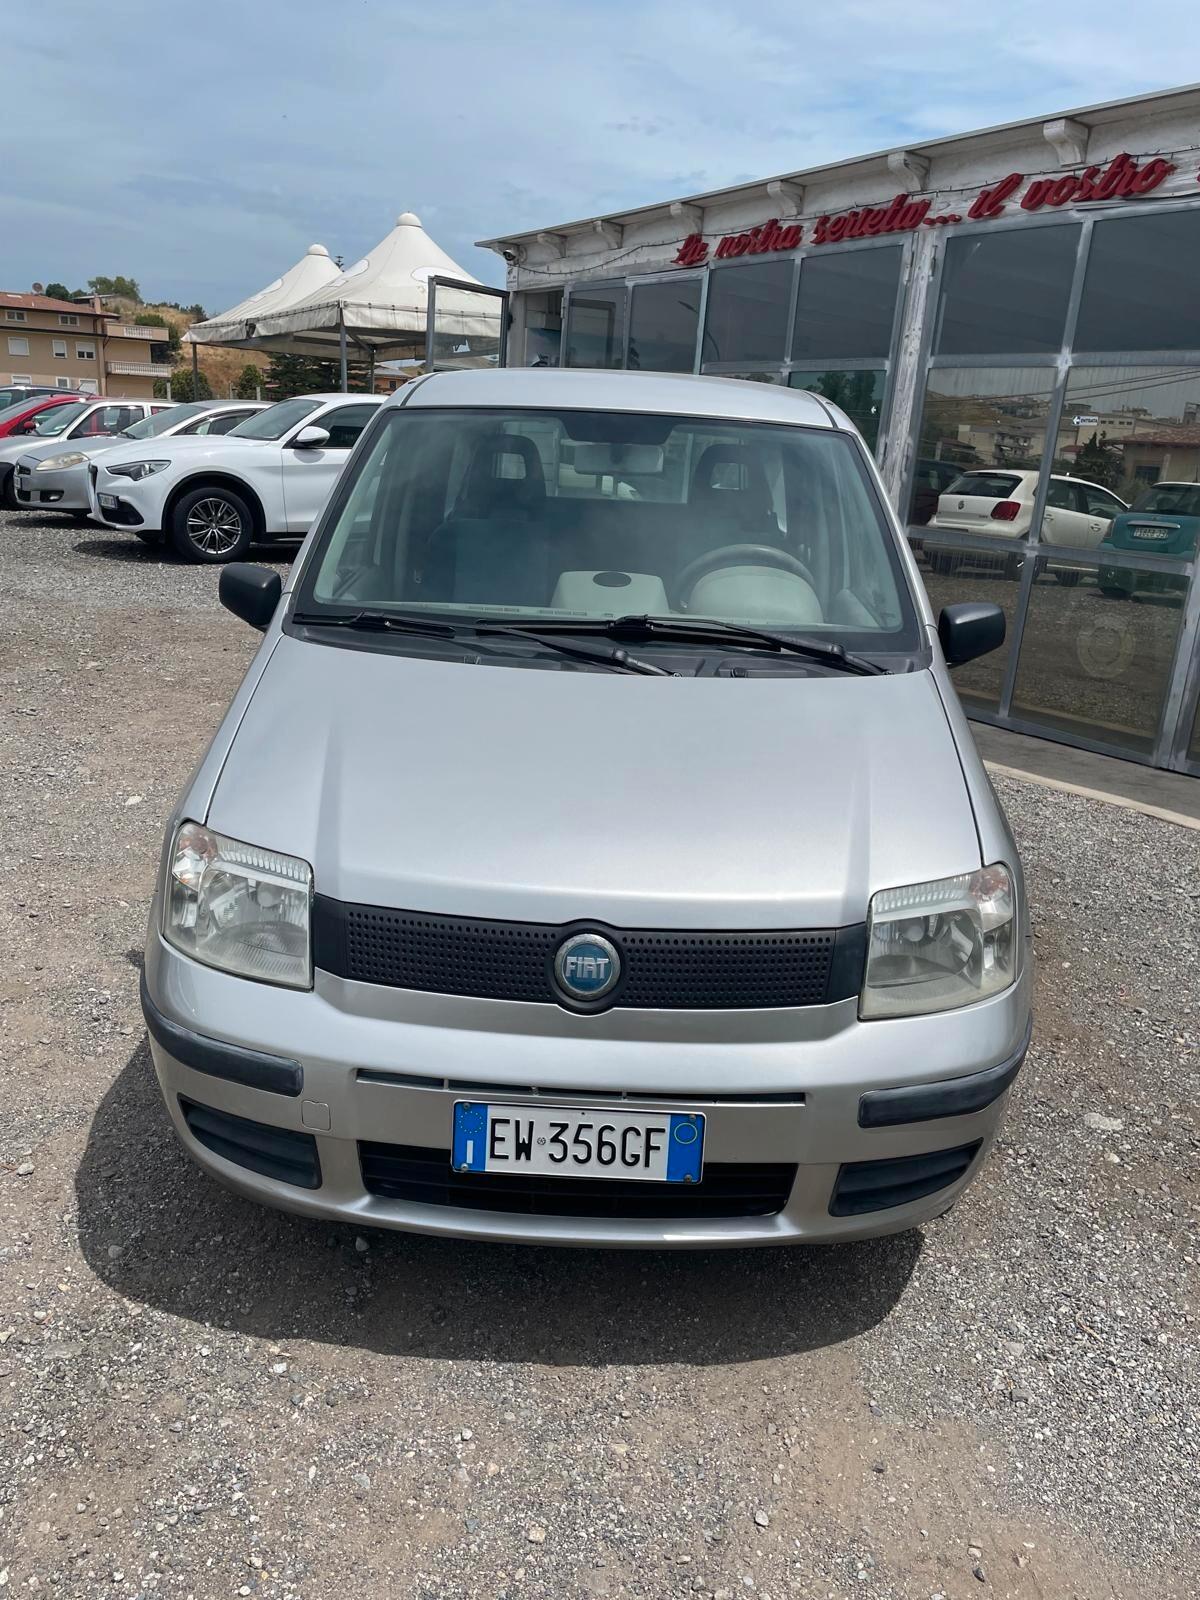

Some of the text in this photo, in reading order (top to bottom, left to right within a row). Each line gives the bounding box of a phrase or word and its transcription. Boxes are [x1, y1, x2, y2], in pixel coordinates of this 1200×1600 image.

[714, 218, 803, 259] nostra
[967, 172, 1024, 219] il
[1020, 153, 1178, 211] vostro
[565, 956, 610, 979] FIAT
